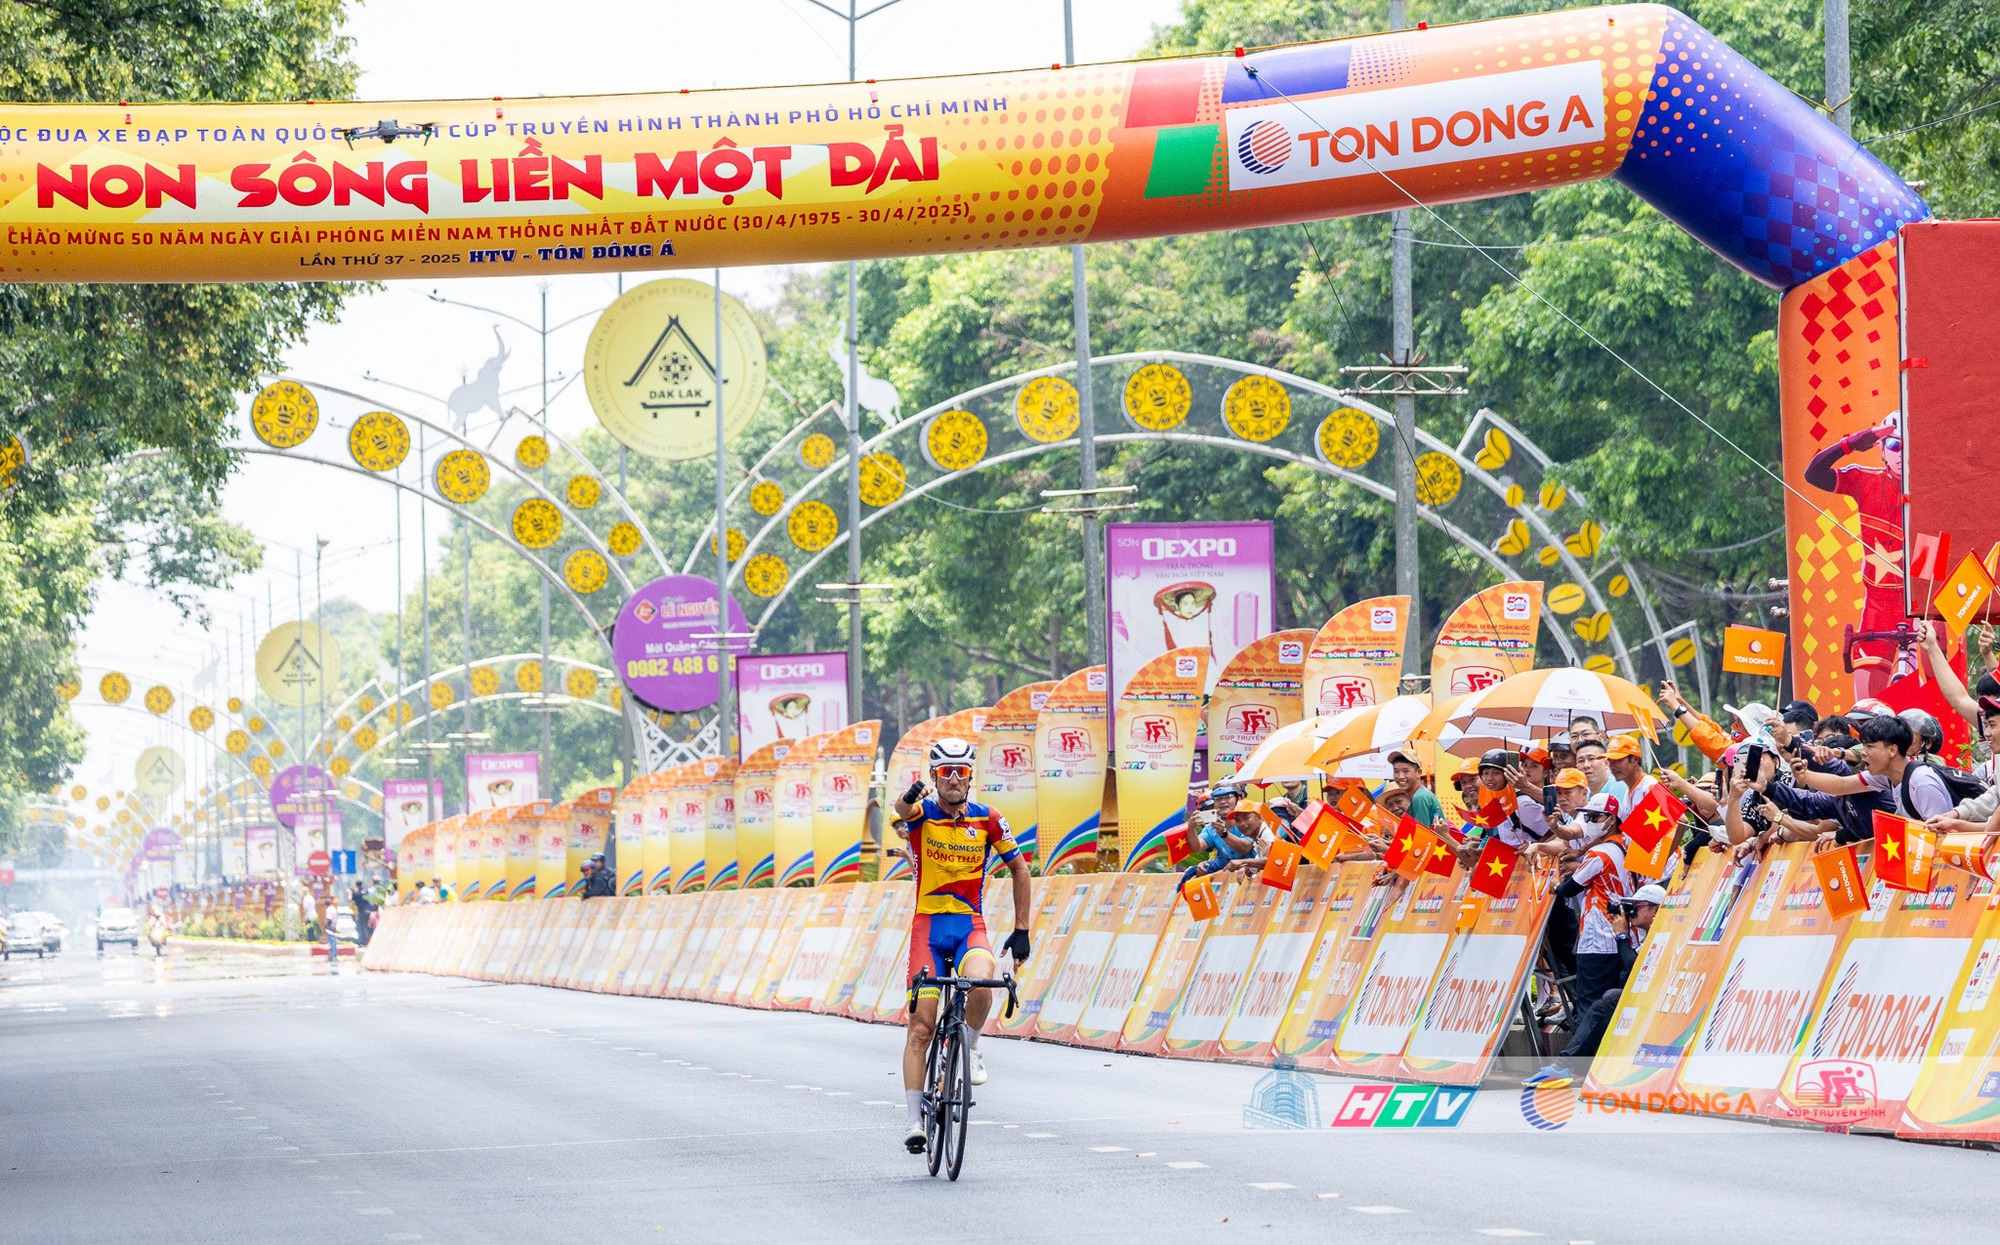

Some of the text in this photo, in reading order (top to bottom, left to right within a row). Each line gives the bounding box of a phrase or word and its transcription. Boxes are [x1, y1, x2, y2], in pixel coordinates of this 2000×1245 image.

[37, 128, 88, 142] ĐUA
[97, 129, 127, 142] XE
[137, 128, 188, 146] ĐẠP
[197, 125, 265, 142] TOÀN
[276, 122, 343, 144] QUỐC
[449, 121, 497, 138] CÚP
[506, 115, 608, 136] TRUYỀN
[618, 111, 682, 132] HÌNH
[690, 108, 780, 129] THÀNH
[788, 102, 839, 124] PHỐ
[848, 100, 882, 120] HỒ
[890, 99, 931, 118] CHÍ
[941, 97, 1008, 113] MINH
[1298, 94, 1595, 168] TON DONG A
[37, 124, 940, 214] NON SÔNG LIỀN MỘT DẢI
[8, 228, 61, 245] CHÀO
[67, 228, 125, 245] MỪNG
[131, 231, 153, 245] 50
[160, 228, 204, 245] NĂM
[211, 228, 264, 244] NGÀY
[270, 225, 311, 244] GIẢI
[316, 226, 385, 243] PHÓNG
[391, 222, 441, 242] MIỀN
[497, 218, 564, 239] THỐNG
[570, 216, 624, 237] NHẤT
[630, 214, 669, 235] ĐẤT
[675, 214, 727, 232] NƯỚC
[733, 211, 841, 231] (30/4/1975
[859, 202, 970, 222] 30/4/2025)
[300, 252, 336, 266] LẦN
[342, 252, 380, 266] THỨ
[385, 255, 405, 265] 37
[421, 254, 460, 264] 2025
[468, 249, 516, 263] HTV
[537, 243, 585, 261] TÔN
[592, 241, 653, 259] ĐÔNG
[659, 239, 676, 256] Á
[649, 389, 703, 399] DAK LAK
[1117, 537, 1237, 561] SƠN OEXPO
[1955, 605, 1969, 619] TON
[1964, 588, 1978, 608] DONG
[627, 653, 737, 679] 0982 488 65
[760, 662, 825, 680] OEXPO
[1734, 655, 1748, 663] TON
[1748, 657, 1769, 665] DONG
[1121, 761, 1146, 770] HTV
[926, 837, 984, 853] DƯỢC DOMESCO
[956, 854, 982, 864] THÁP
[1839, 866, 1850, 888] DONG
[1363, 975, 1429, 1028] TON DONG A
[1435, 978, 1507, 1035] TON DONG A
[1717, 989, 1811, 1055] TON DONG A
[1828, 993, 1945, 1064] TON DONG A
